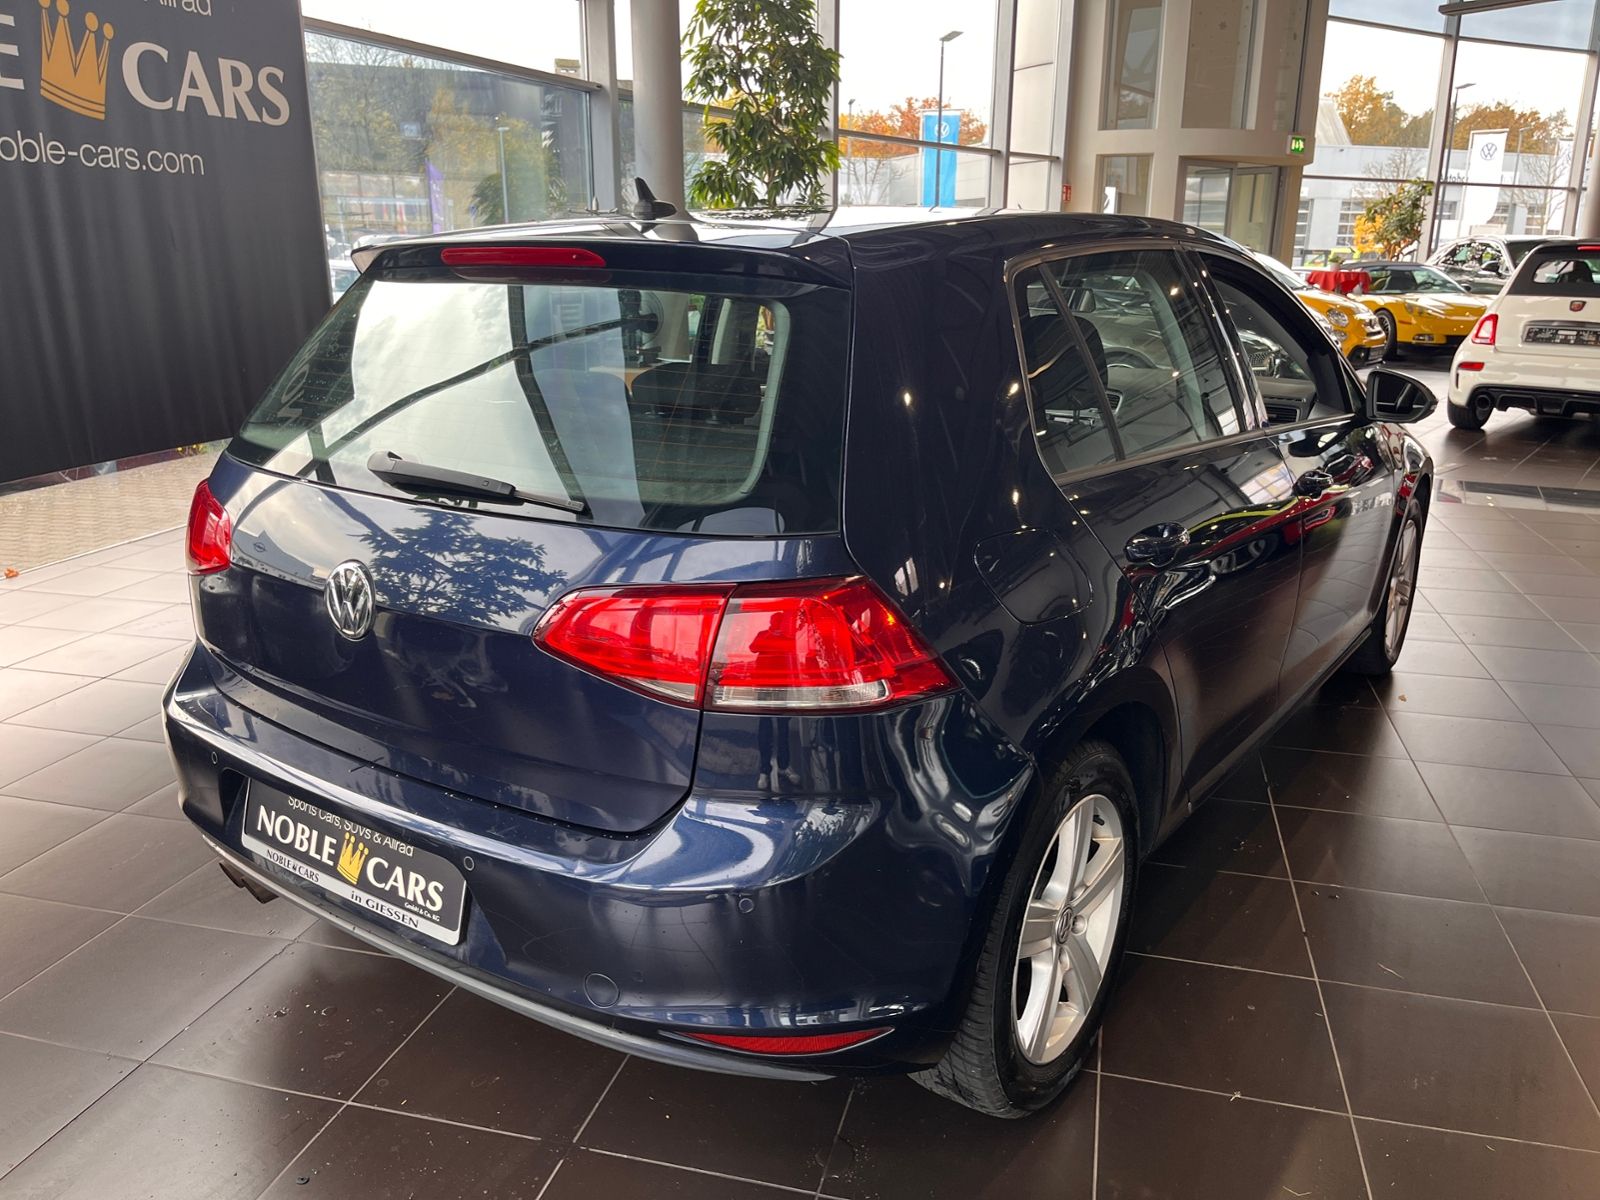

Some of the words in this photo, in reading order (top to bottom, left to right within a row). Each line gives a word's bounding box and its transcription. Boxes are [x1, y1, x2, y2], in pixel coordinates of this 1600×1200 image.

[121, 41, 290, 127] CARS
[256, 804, 338, 867] NOBLE
[366, 856, 445, 912] CARS
[266, 848, 292, 870] NOBLE
[297, 864, 320, 883] CARS
[350, 890, 362, 903] in
[365, 898, 419, 928] GIESSEN
